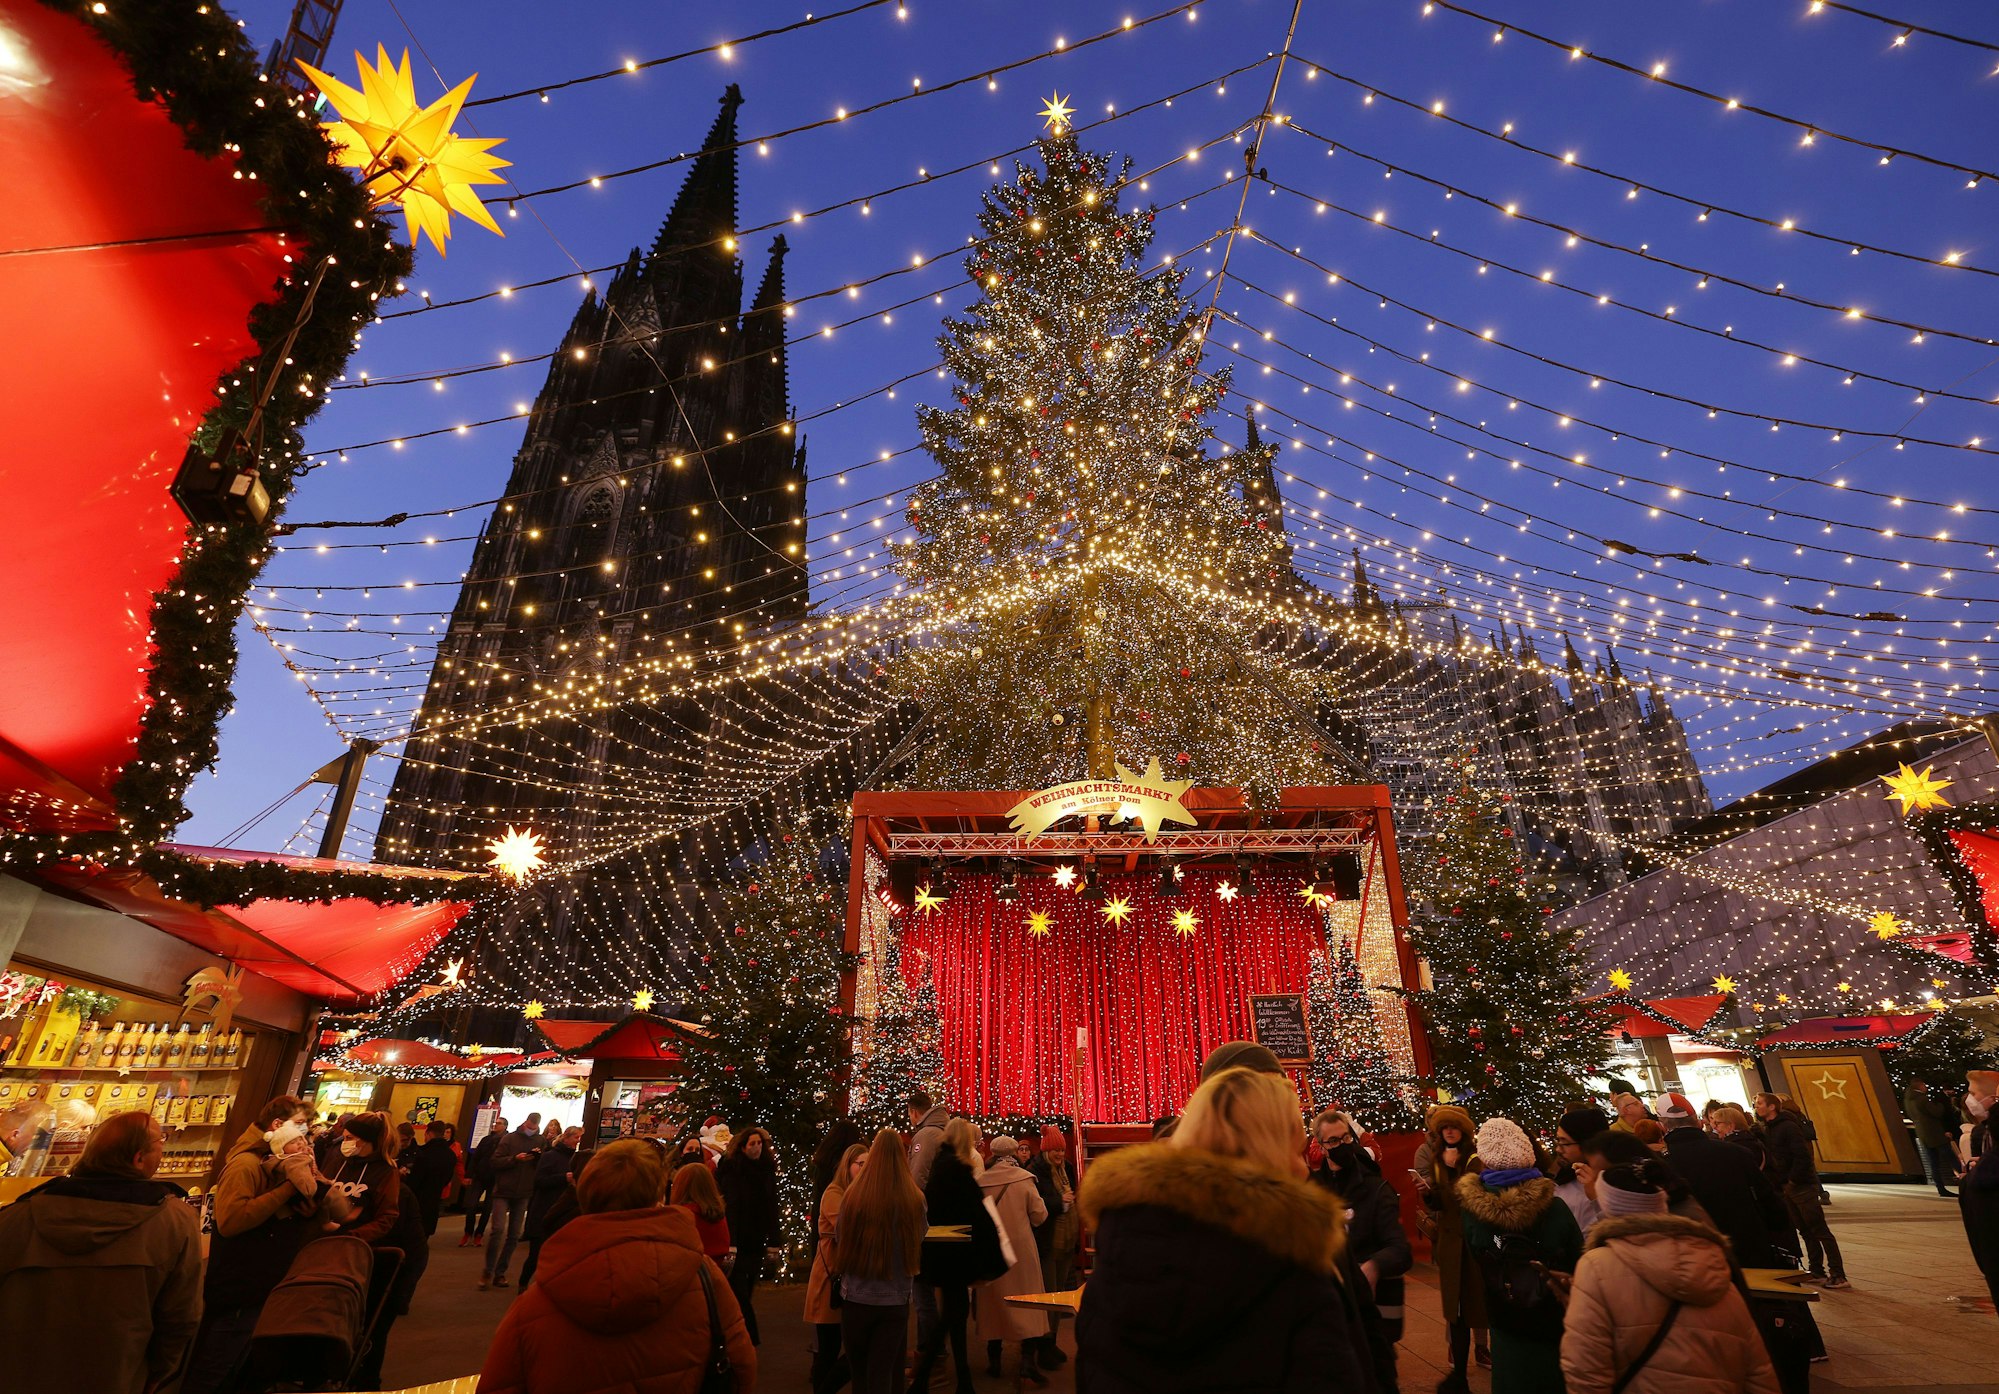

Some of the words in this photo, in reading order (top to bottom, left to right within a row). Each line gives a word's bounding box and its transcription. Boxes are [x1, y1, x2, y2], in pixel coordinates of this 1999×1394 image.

[1029, 783, 1173, 809] WEIHNACHTSMARKT
[1061, 801, 1076, 809] am
[1081, 796, 1116, 804] Kölner
[1118, 795, 1141, 804] Dom
